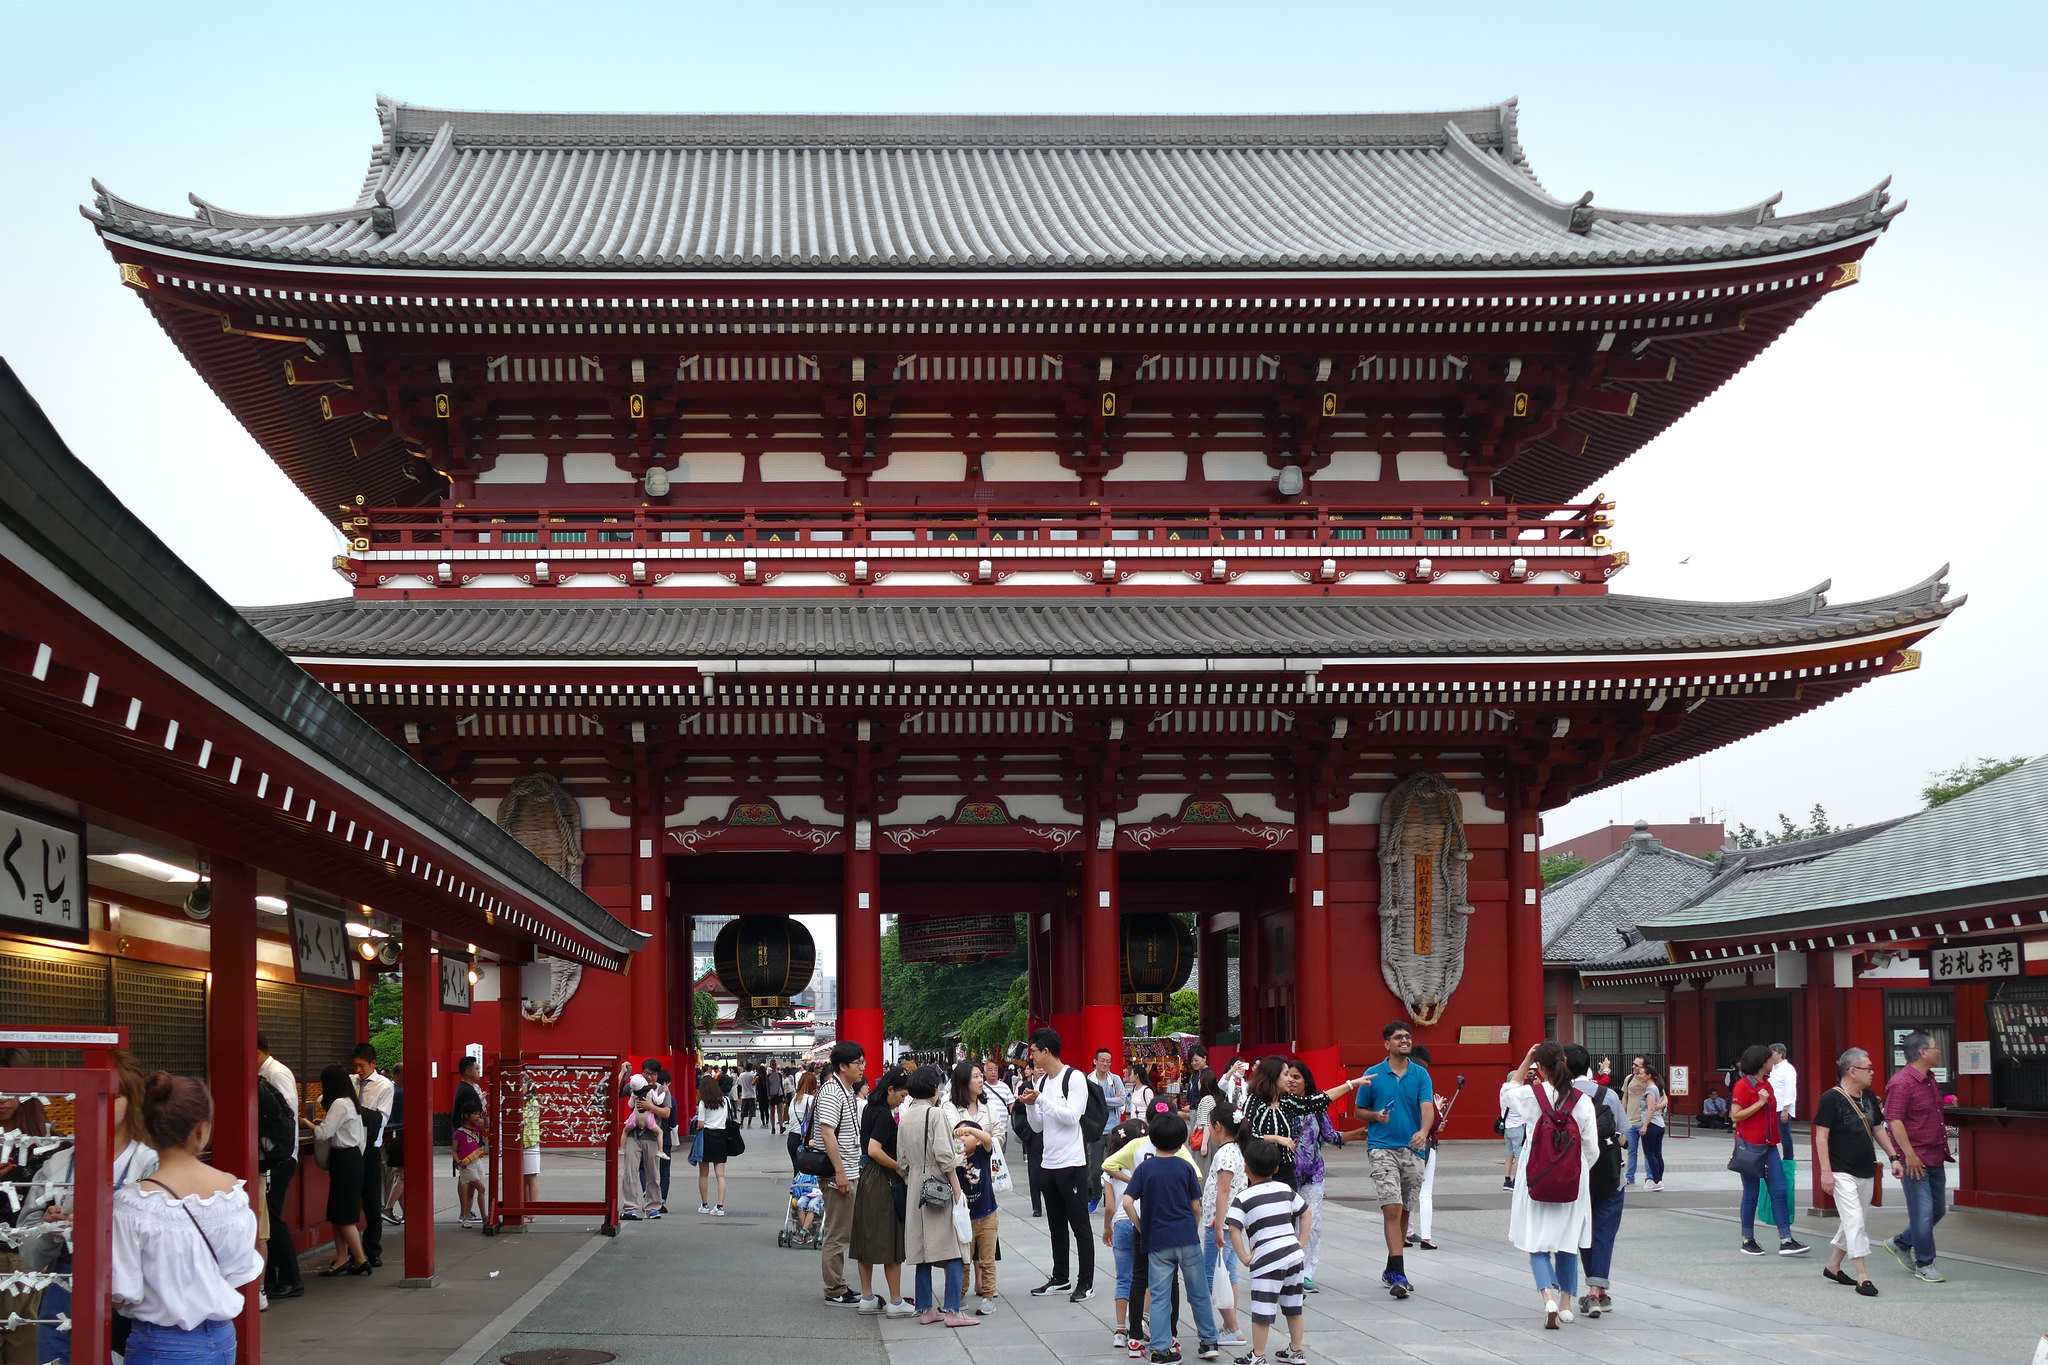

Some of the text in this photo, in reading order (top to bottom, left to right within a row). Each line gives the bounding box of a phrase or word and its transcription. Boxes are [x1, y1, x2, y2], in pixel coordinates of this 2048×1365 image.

[297, 918, 342, 965] みくじ
[1939, 946, 2014, 977] お札お守
